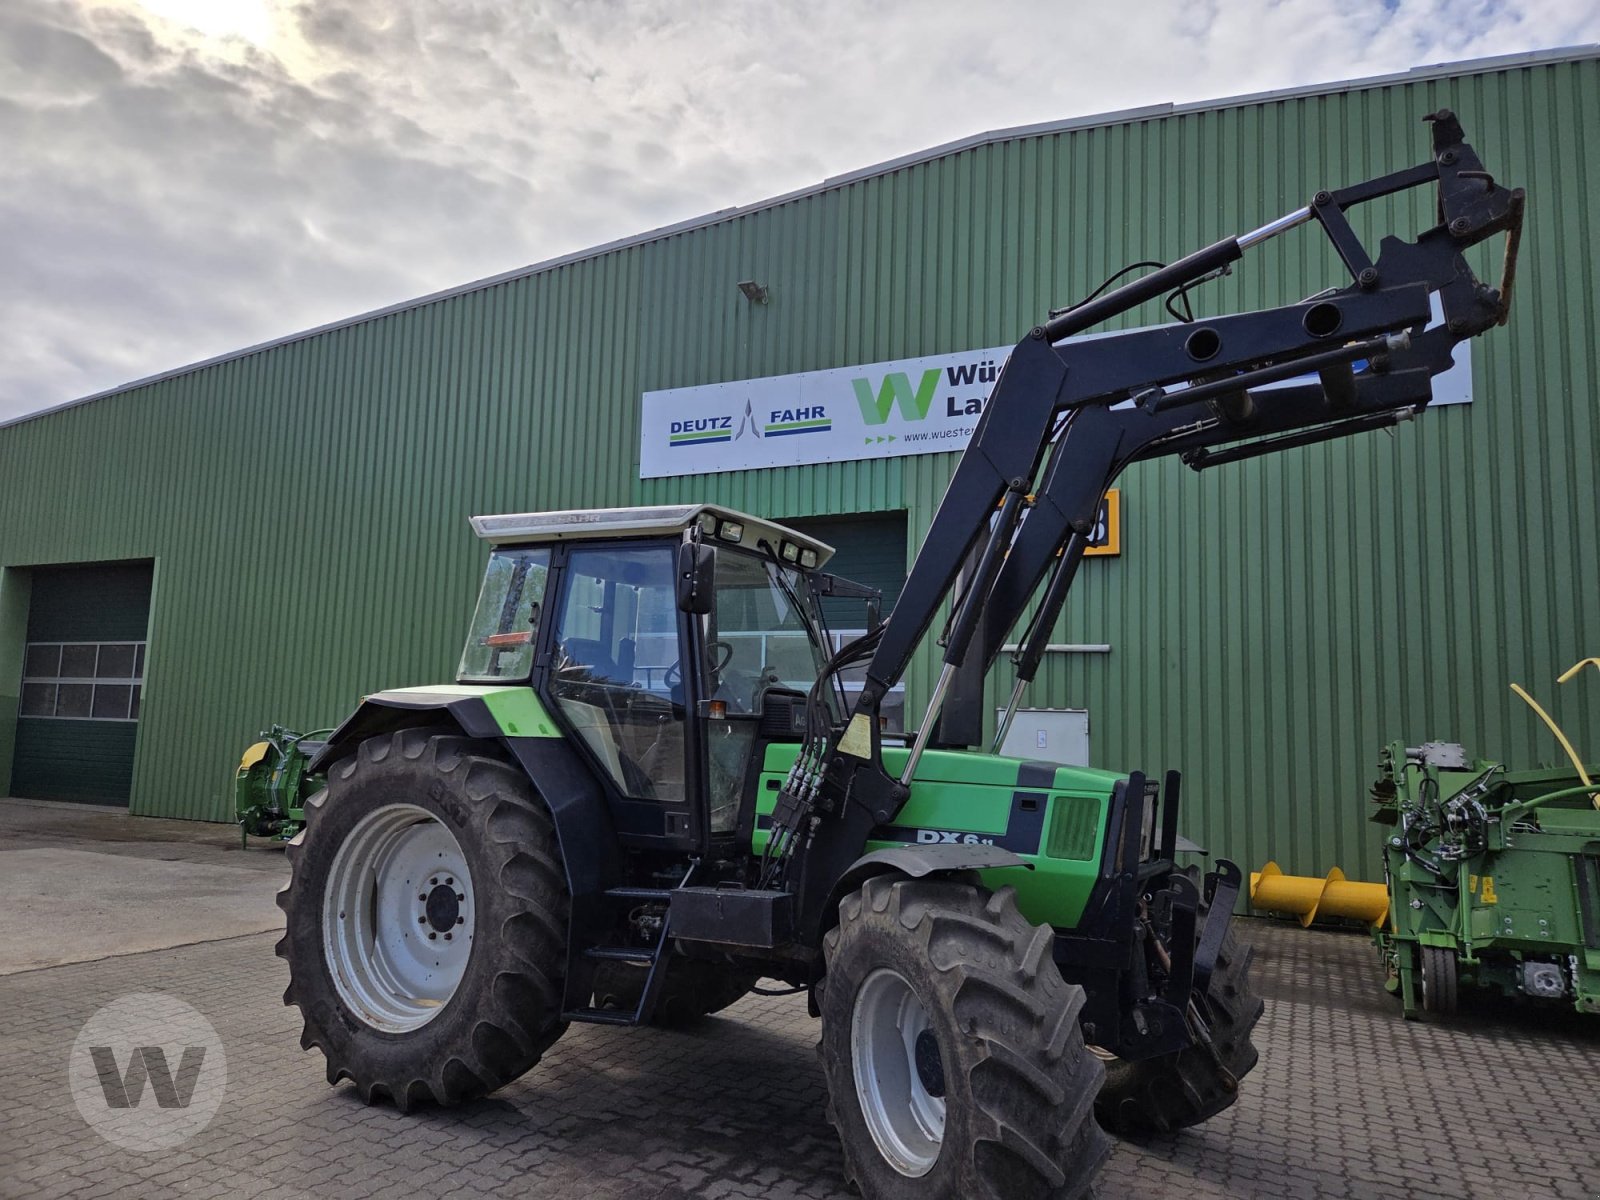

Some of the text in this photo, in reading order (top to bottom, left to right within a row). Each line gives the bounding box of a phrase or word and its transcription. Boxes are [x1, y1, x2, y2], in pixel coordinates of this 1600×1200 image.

[947, 397, 987, 417] La
[671, 406, 826, 434] DEUTZ FAHR
[917, 829, 960, 844] DX
